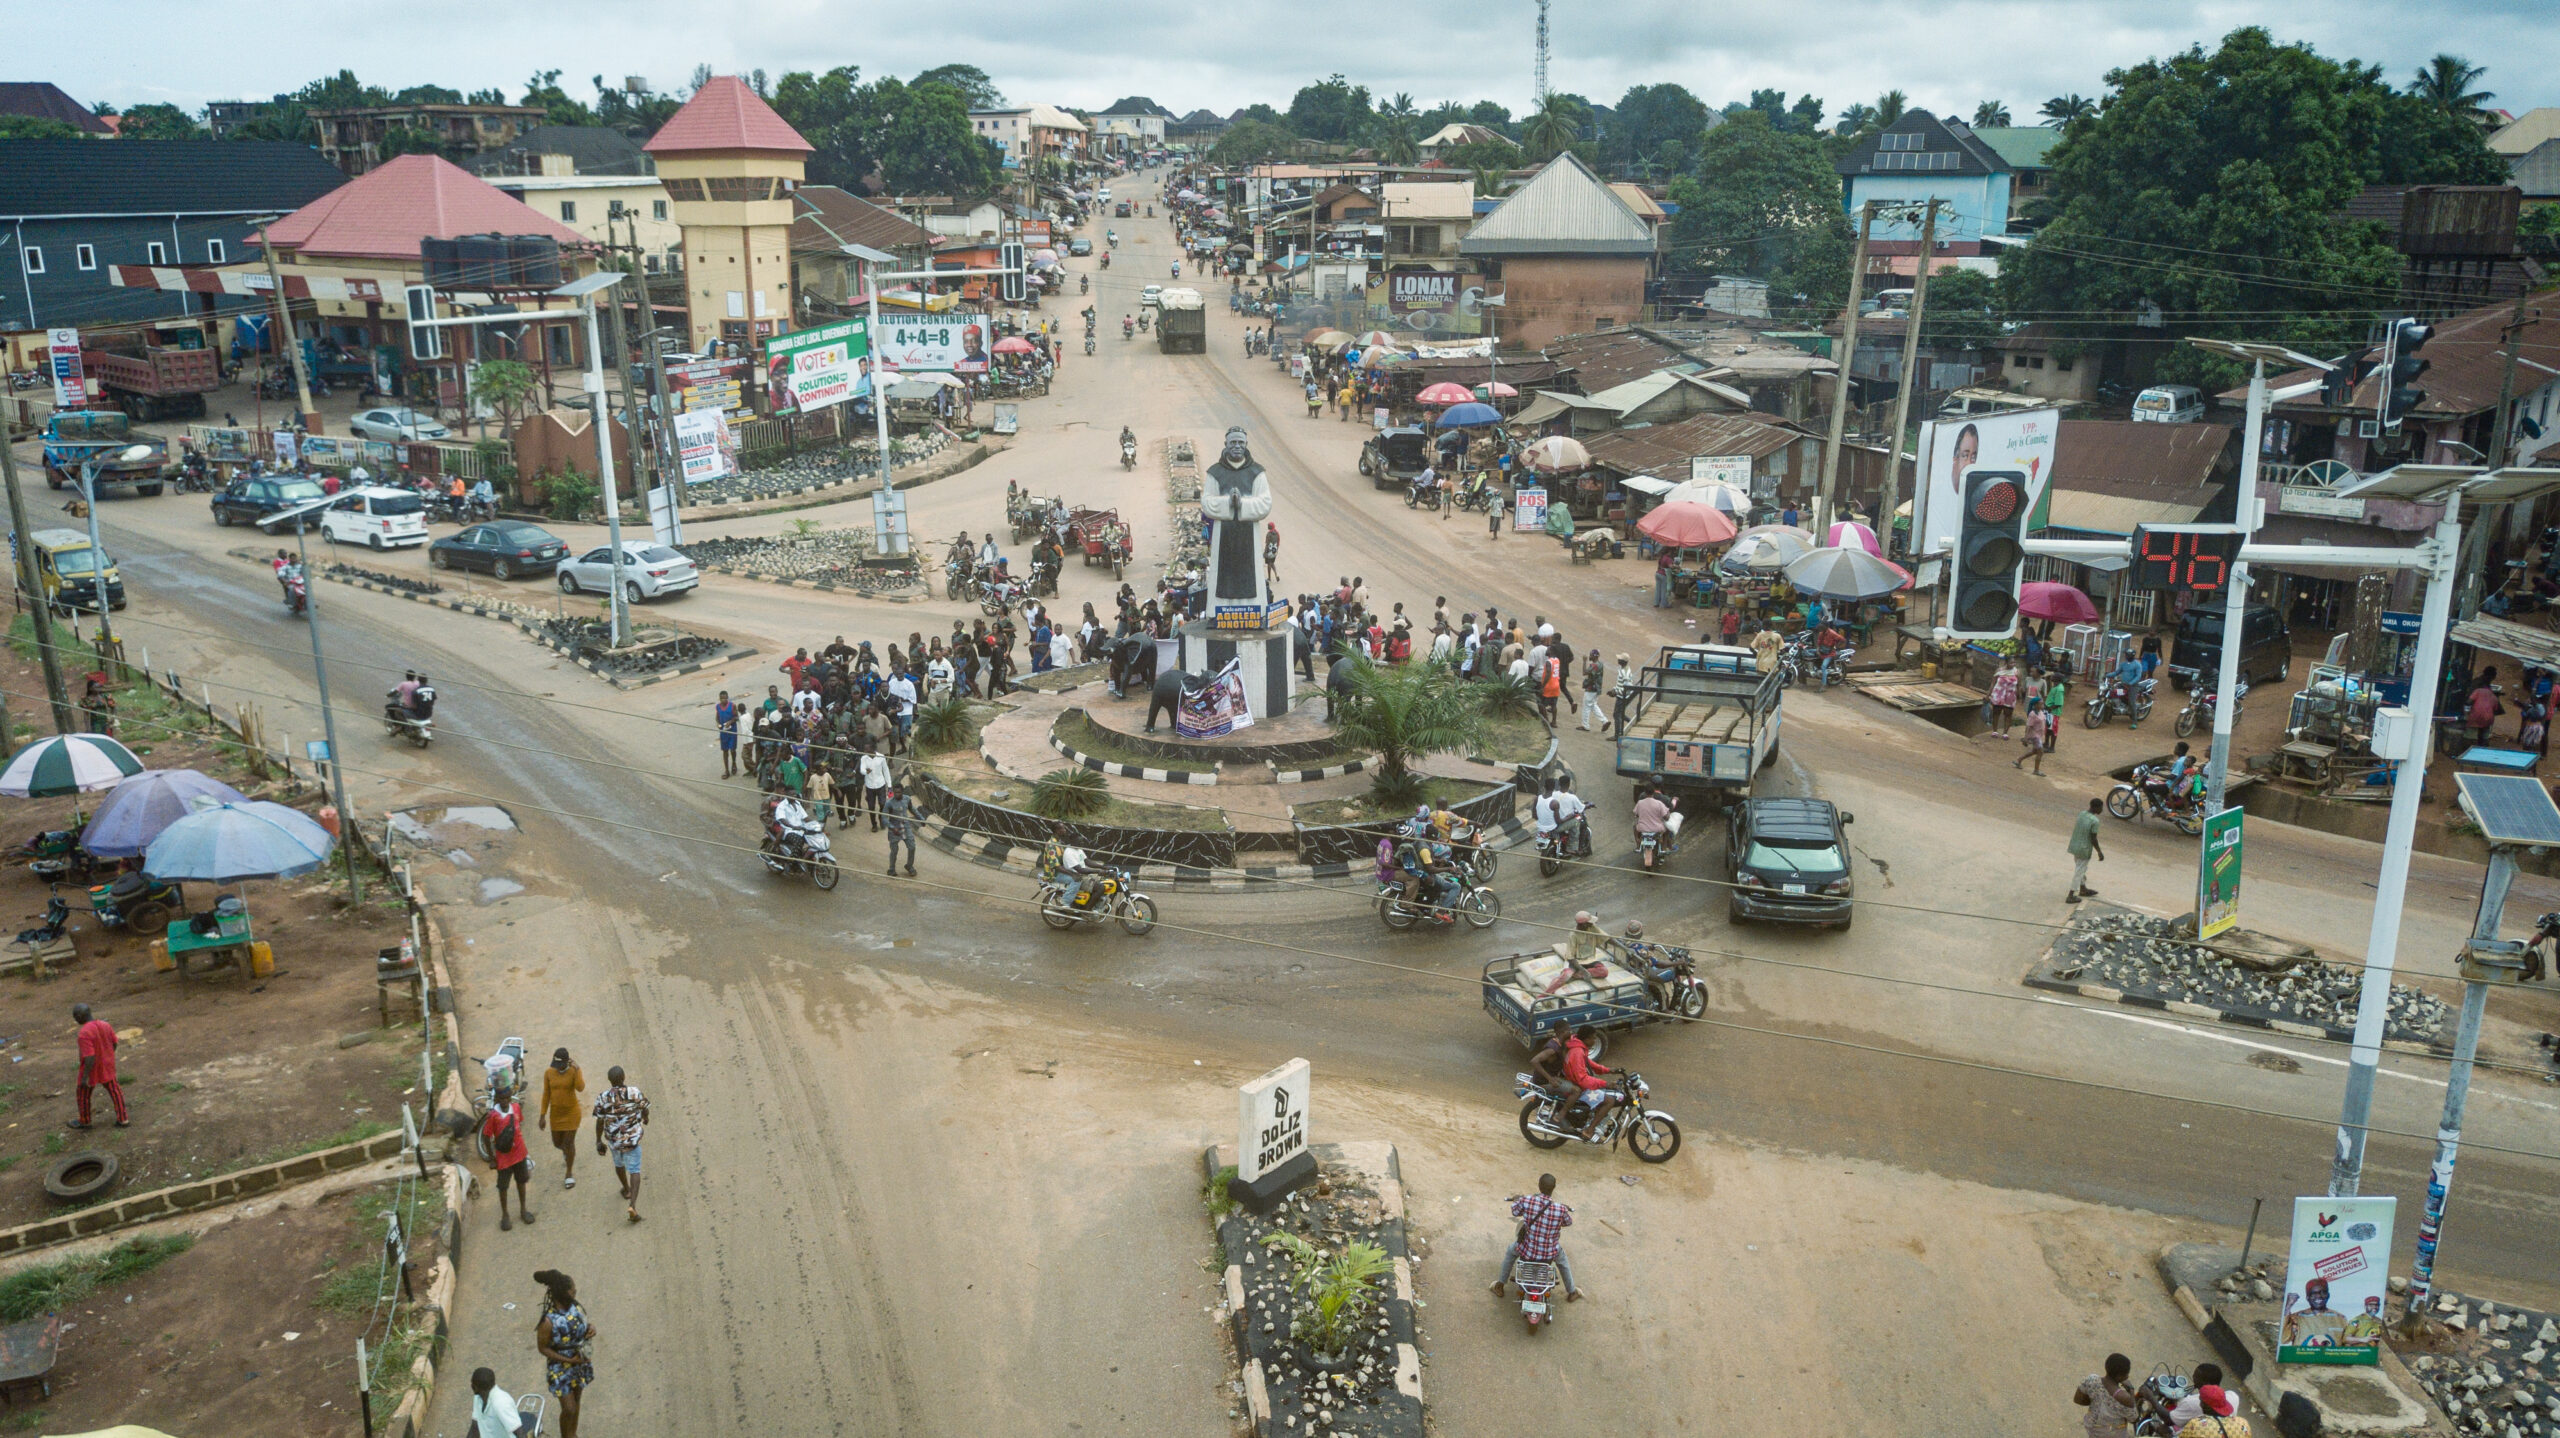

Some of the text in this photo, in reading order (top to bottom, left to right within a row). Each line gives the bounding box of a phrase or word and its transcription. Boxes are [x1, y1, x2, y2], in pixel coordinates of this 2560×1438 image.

[1395, 276, 1454, 295] LONAX
[878, 315, 977, 325] OLUTION CONTINUES!
[896, 328, 950, 346] 4+4=8
[795, 351, 826, 372] VOTE
[798, 374, 839, 393] SOLUTION
[800, 383, 848, 404] CONTINUITY
[2006, 438, 2017, 450] Joy
[2025, 433, 2048, 446] Coming
[1518, 495, 1545, 506] POS
[2141, 531, 2226, 590] 46
[1495, 993, 1519, 1020] DAYUN
[1262, 1110, 1301, 1148] DOLIZ
[1258, 1129, 1302, 1171] BROWN
[2310, 1231, 2340, 1239] APGA
[2322, 1257, 2358, 1274] SOLUTION
[2323, 1262, 2362, 1279] CONTINUES
